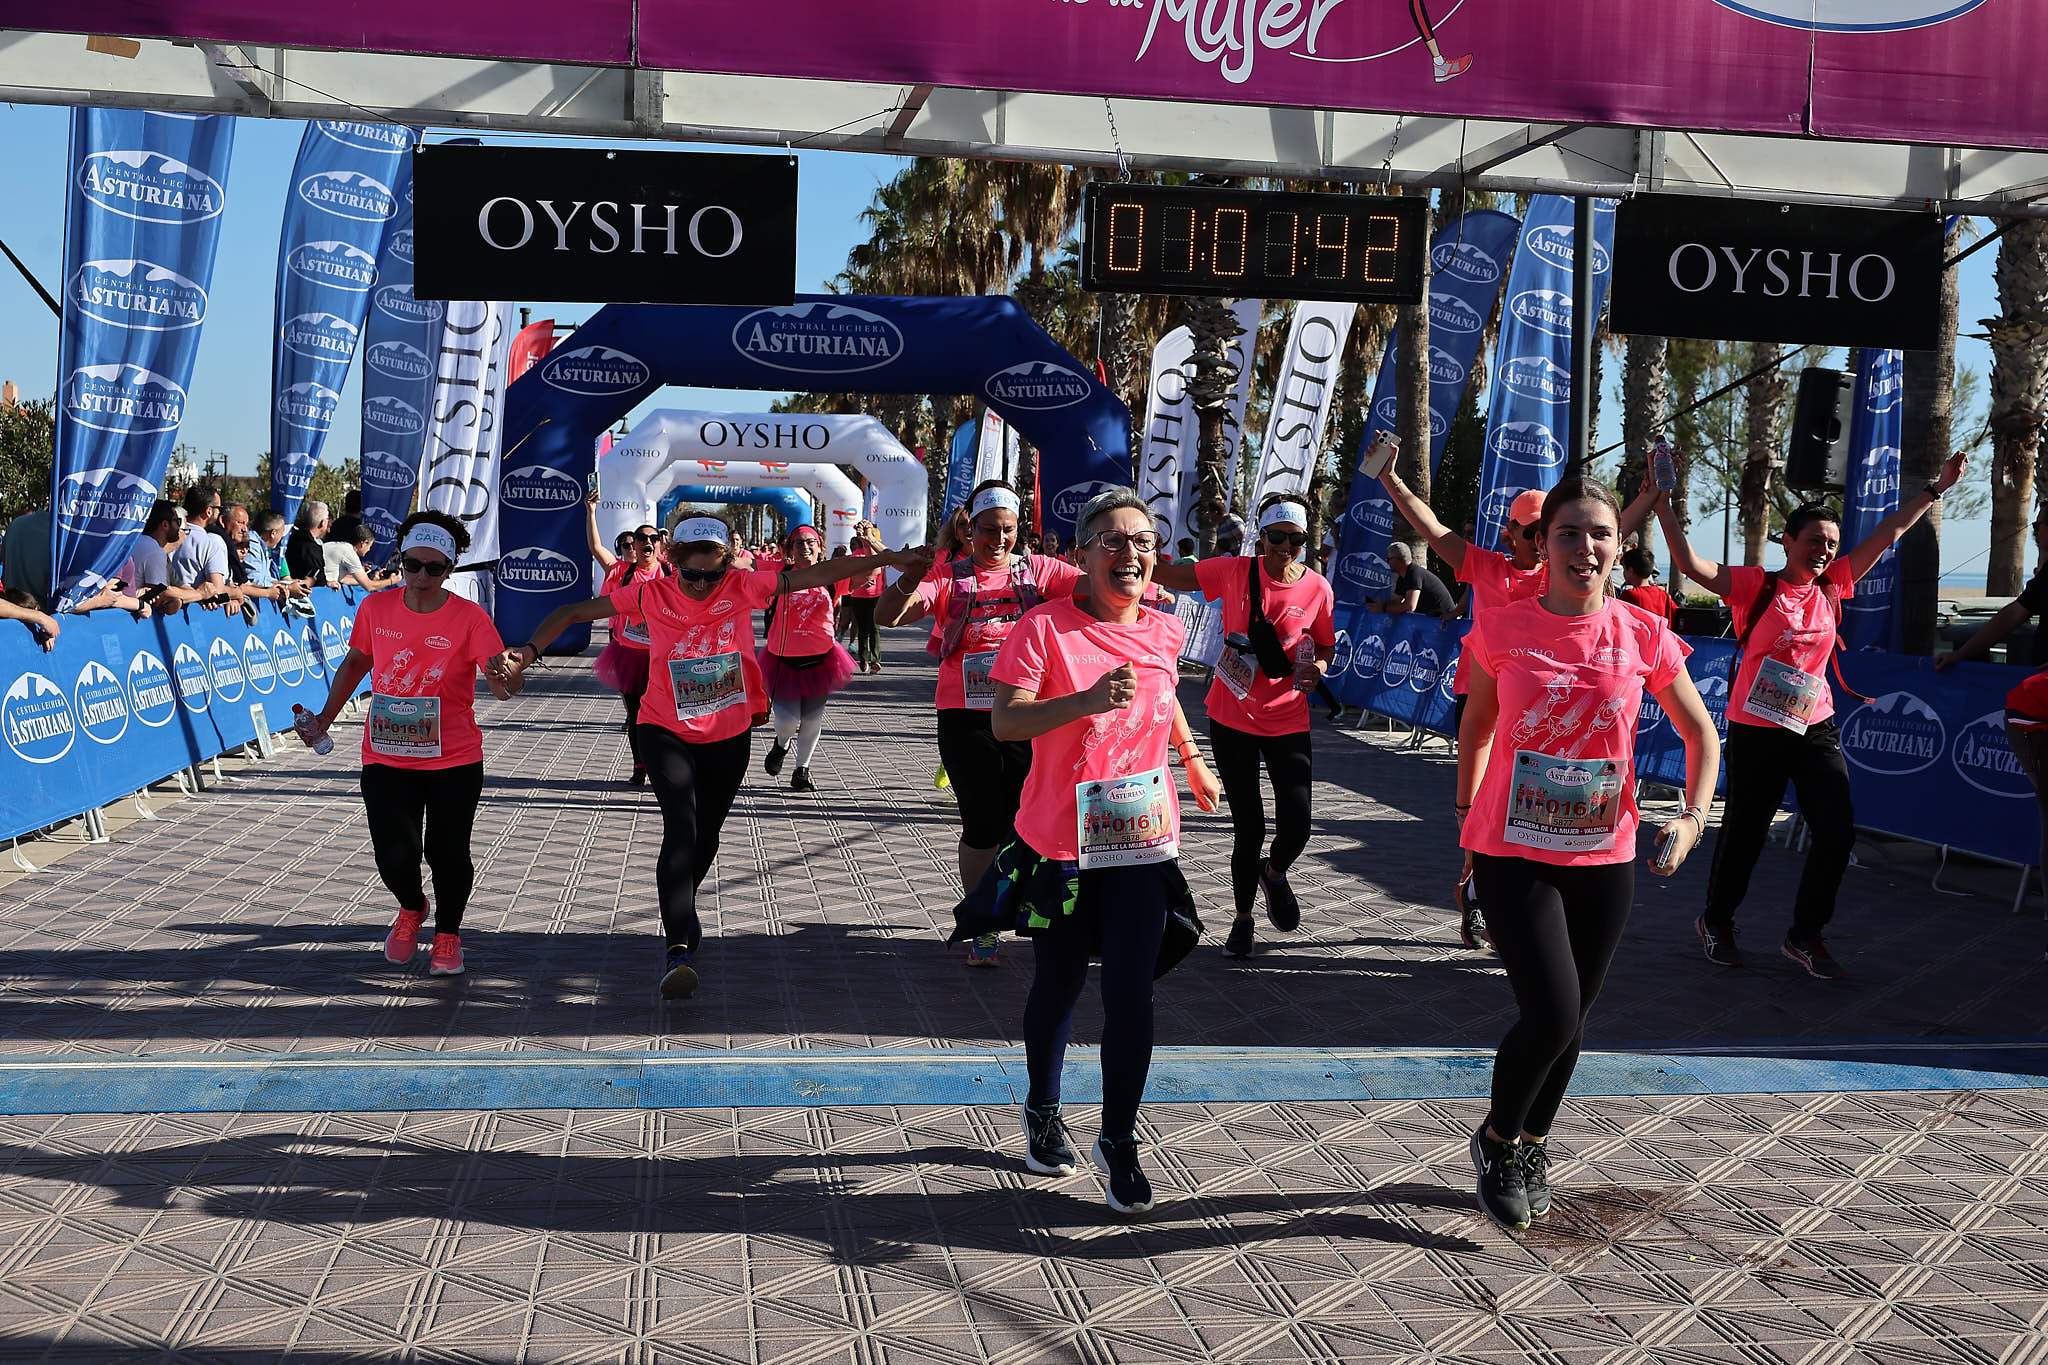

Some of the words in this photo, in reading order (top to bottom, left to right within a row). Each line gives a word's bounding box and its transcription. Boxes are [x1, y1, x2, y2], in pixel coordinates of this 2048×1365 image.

[1135, 0, 1344, 84] Mujer
[84, 163, 214, 212] ASTURIANA
[106, 167, 158, 184] CENTRAL
[163, 178, 210, 192] LECHERA
[306, 181, 389, 216] ASTURIANA
[478, 196, 743, 258] OYSHO
[1108, 203, 1400, 283] 01:01:42
[1436, 248, 1493, 280] ASTURIANA
[1668, 242, 1896, 302] OYSHO
[78, 274, 199, 320] ASTURIANA
[95, 276, 143, 291] CENTRAL
[149, 285, 197, 299] LECHERA
[378, 291, 436, 318] ASTURIANA
[772, 321, 827, 331] CENTRAL
[831, 323, 886, 333] LECHERA
[745, 322, 891, 356] ASTURIANA
[370, 352, 427, 376] ASTURIANA
[549, 363, 641, 384] ASTURIANA
[994, 379, 1085, 398] ASTURIANA
[68, 382, 179, 422] ASTURIANA
[364, 404, 418, 430] ASTURIANA
[700, 420, 830, 450] OYSHO
[620, 449, 660, 458] OYSHO
[866, 454, 905, 463] OYSHO
[365, 465, 409, 485] STURIANA
[503, 481, 576, 501] ASTURIANA
[602, 501, 639, 510] OYSHO
[885, 508, 921, 518] OYSHO
[500, 562, 573, 582] ASTURIANA
[662, 607, 689, 622] OYSHO
[376, 627, 403, 639] OYSHO
[1066, 653, 1107, 665] OYSHO
[1509, 647, 1554, 659] OYSHO
[177, 671, 210, 698] ASTURIANA
[132, 682, 174, 712] ASTURIANA
[16, 704, 40, 716] CENTRAL
[42, 699, 64, 711] LECHERA
[80, 695, 126, 727] ASTURIANA
[9, 710, 72, 745] ASTURIANA
[1845, 718, 1934, 758] ASTURIANA
[1548, 770, 1590, 782] ASTURIANA
[1109, 789, 1146, 800] ASTURIANA
[1546, 799, 1587, 816] 016
[1112, 814, 1150, 833] 016
[1513, 819, 1539, 830] CARRERA
[1540, 824, 1549, 832] DE
[1559, 827, 1579, 835] MUJER
[1584, 826, 1609, 835] VALENCIA
[1085, 843, 1110, 852] CARRERA
[1128, 841, 1147, 849] MUJER
[1121, 833, 1140, 842] 5878
[1517, 831, 1552, 844] OYSHO
[1091, 854, 1123, 863] OYSHO
